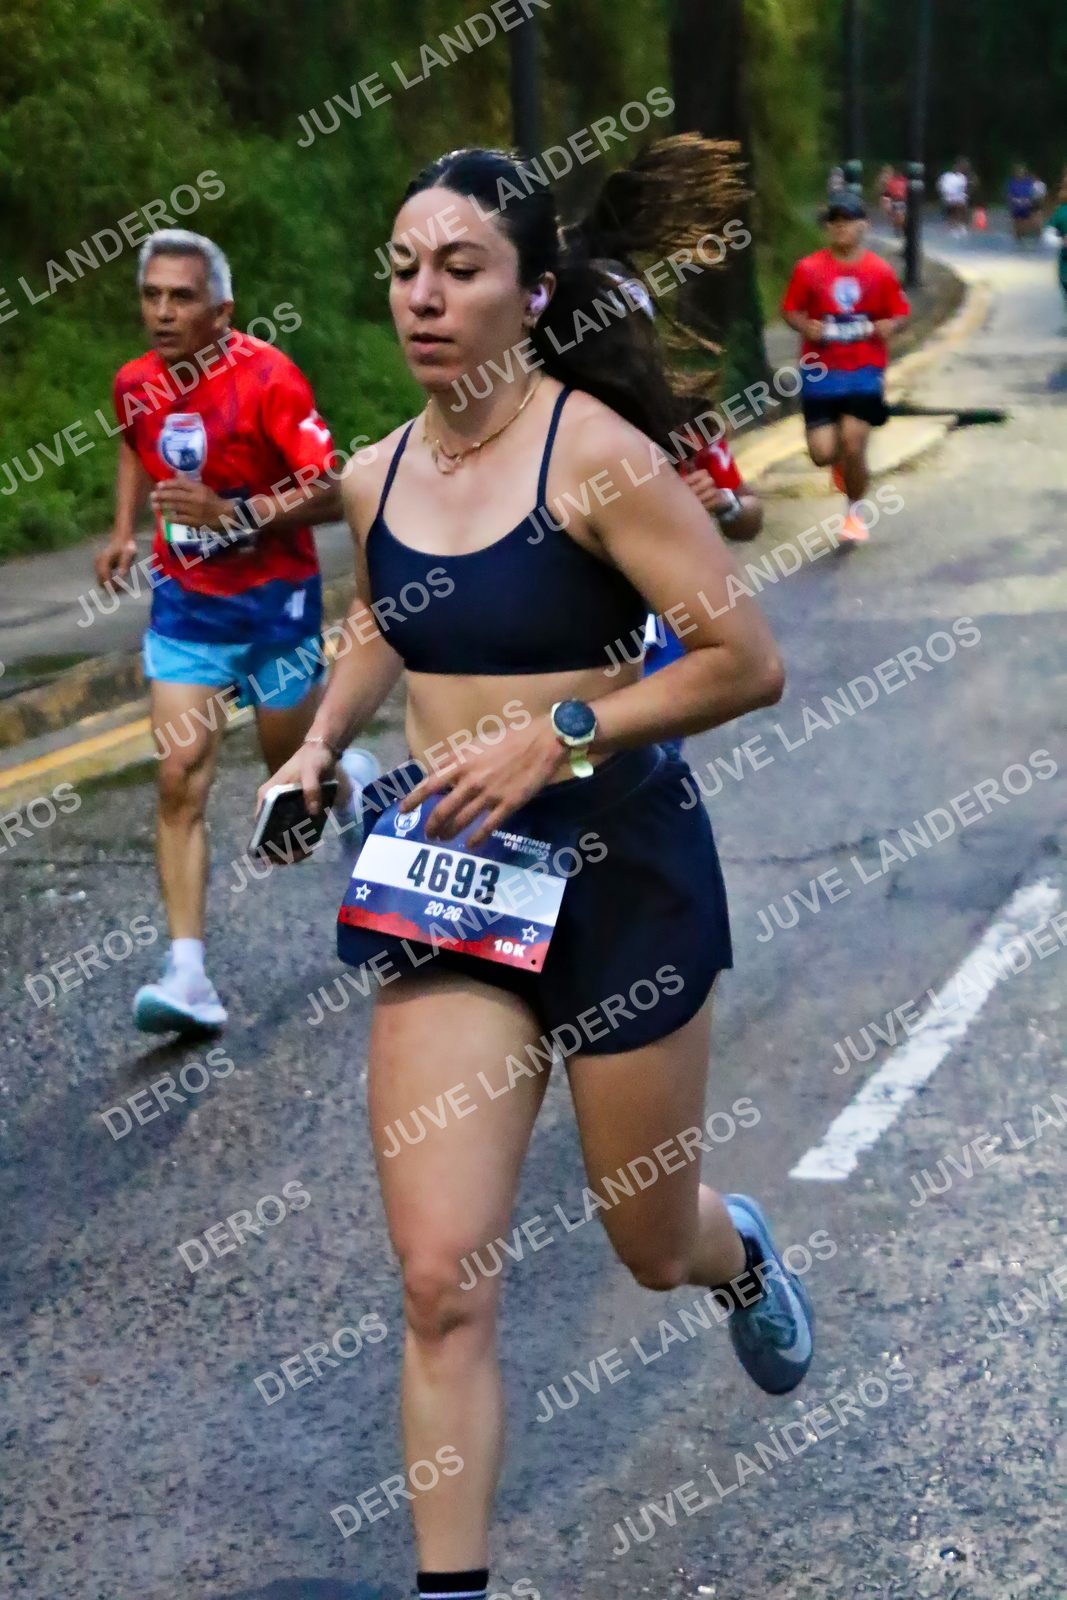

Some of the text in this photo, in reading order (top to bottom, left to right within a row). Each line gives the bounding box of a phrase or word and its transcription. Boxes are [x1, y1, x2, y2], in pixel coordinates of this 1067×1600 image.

[490, 829, 552, 850] OMPARTIMOS
[407, 848, 500, 905] 4693
[494, 938, 527, 957] 10K
